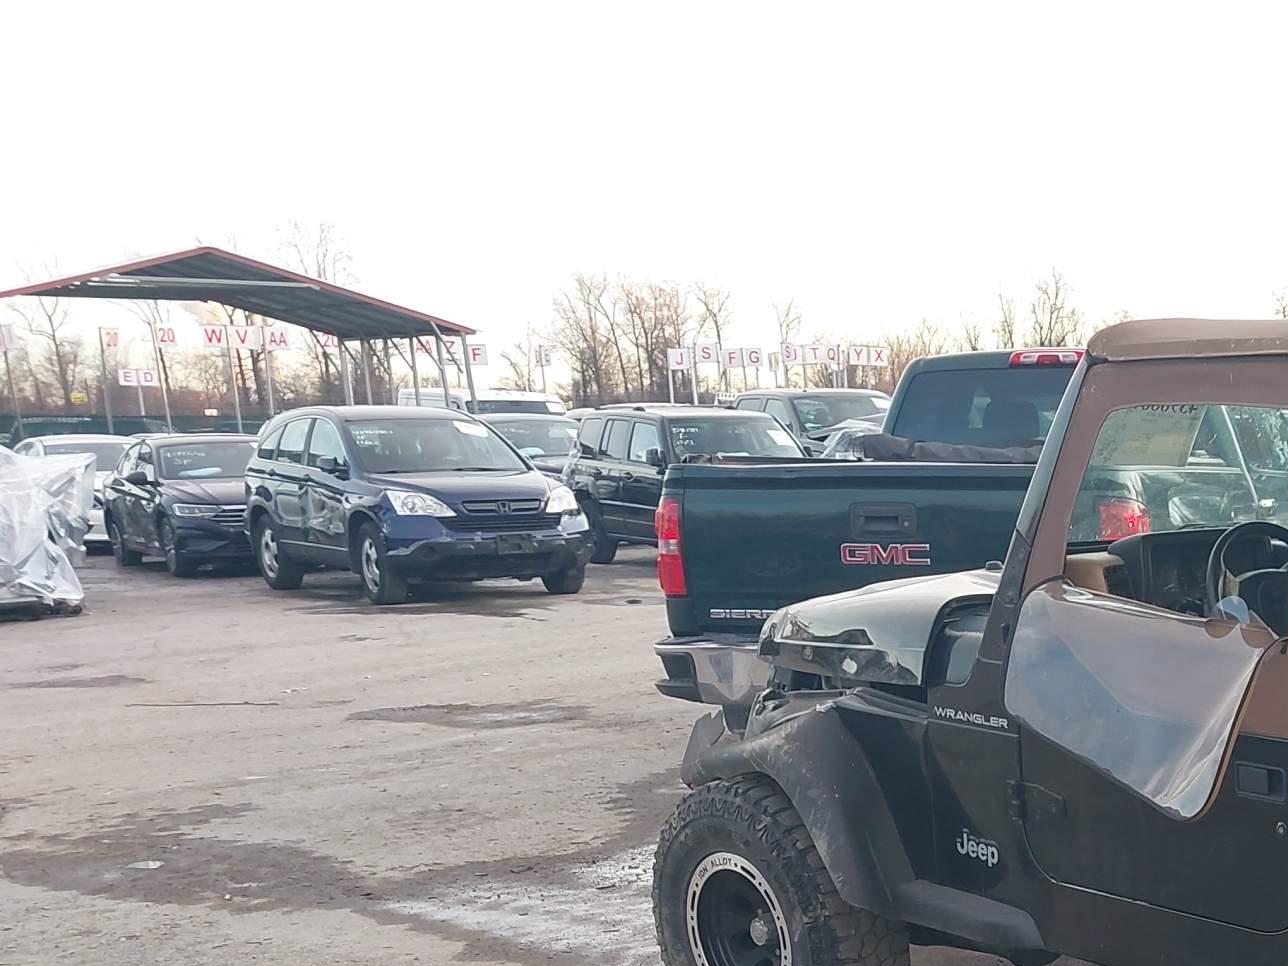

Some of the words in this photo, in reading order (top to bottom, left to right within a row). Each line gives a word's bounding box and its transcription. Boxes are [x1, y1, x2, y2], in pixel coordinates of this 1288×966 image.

[159, 327, 175, 343] 20
[204, 328, 222, 344] W
[236, 329, 247, 344] V
[269, 332, 287, 346] AA
[472, 347, 481, 362] F
[675, 351, 684, 366] J
[701, 346, 712, 360] S
[728, 351, 736, 365] F
[749, 350, 760, 364] G
[810, 347, 818, 360] T
[854, 348, 863, 361] Y
[875, 350, 883, 362] X
[123, 371, 132, 383] E
[144, 371, 153, 383] D
[840, 543, 930, 565] GMC
[933, 705, 1008, 729] WRANGLER
[956, 830, 999, 867] Jeep
[710, 857, 732, 868] ALLOY
